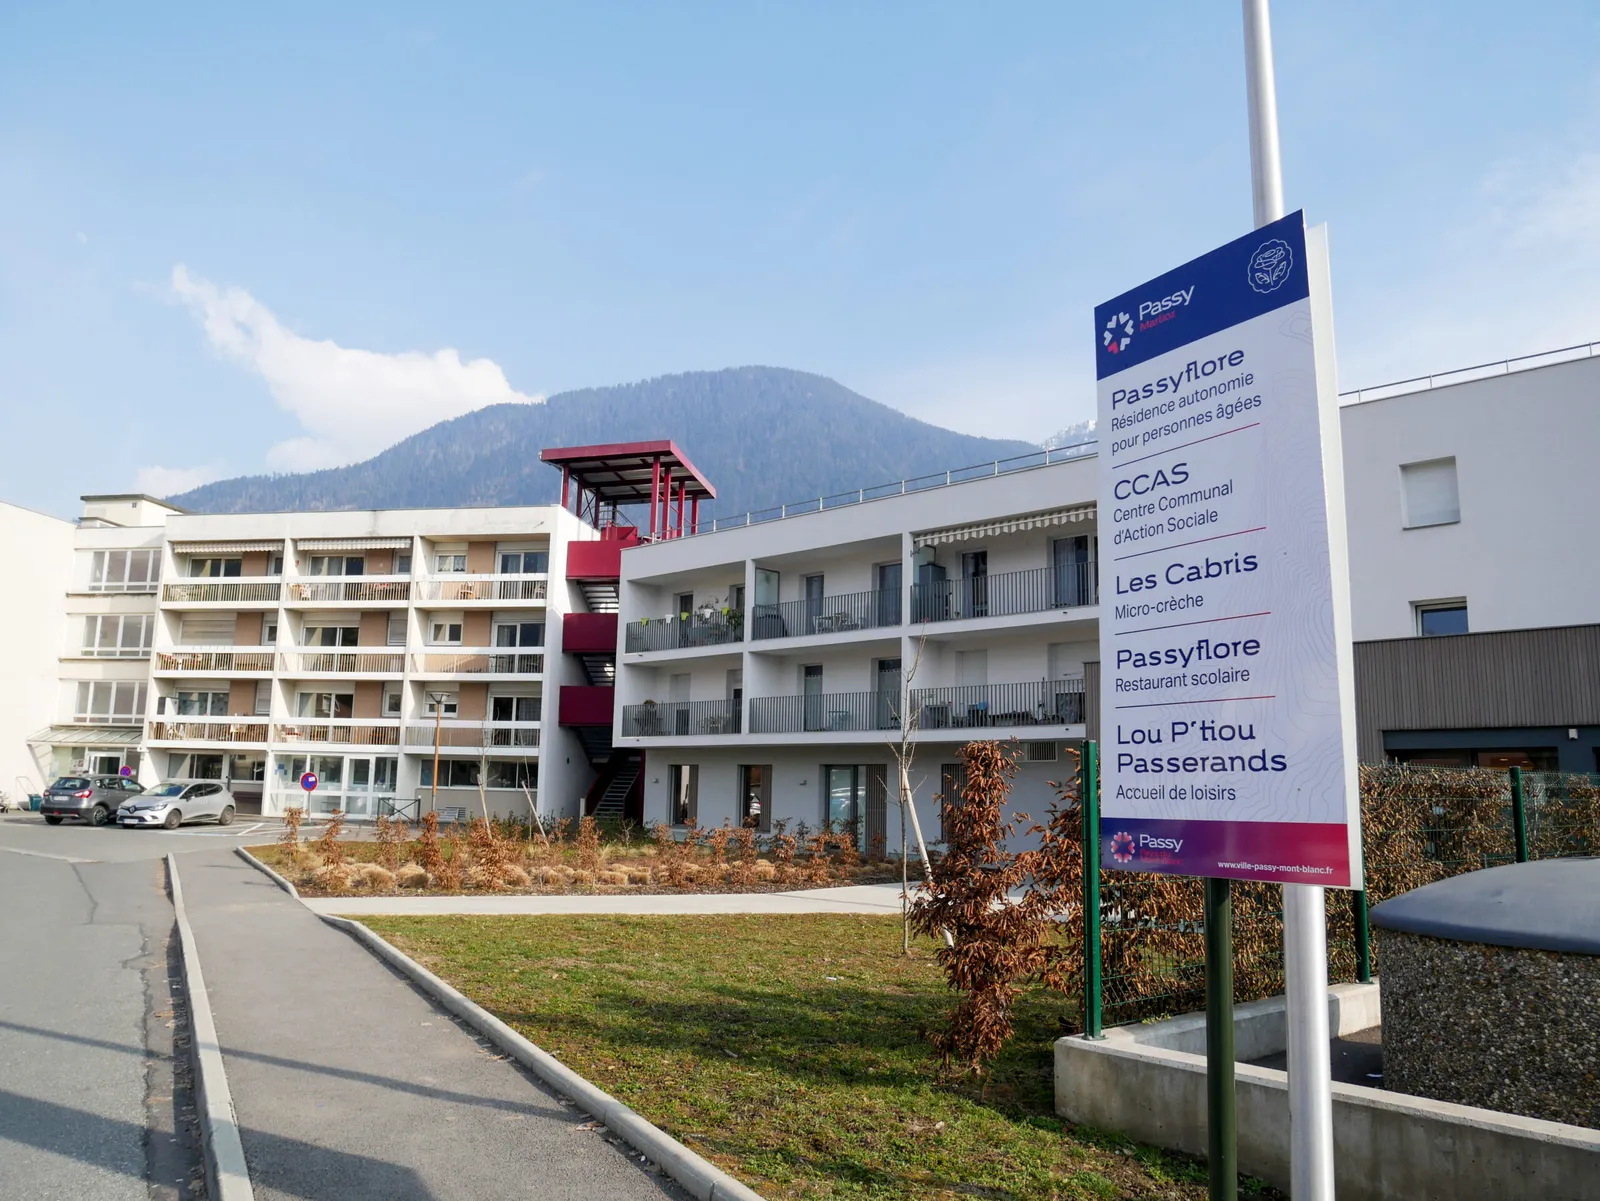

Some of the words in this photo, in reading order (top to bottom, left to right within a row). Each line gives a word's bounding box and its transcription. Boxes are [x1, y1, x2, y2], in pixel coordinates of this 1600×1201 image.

[1139, 285, 1195, 321] Passy
[1112, 350, 1244, 410] Passyflore
[1111, 403, 1175, 431] Résidence
[1178, 372, 1254, 408] autonomie
[1111, 434, 1140, 456] pour
[1142, 410, 1212, 446] personnes
[1215, 394, 1262, 420] âgées
[1114, 463, 1189, 500] CCAS
[1113, 503, 1156, 523] Centre
[1158, 479, 1233, 510] Communal
[1113, 522, 1164, 545] d'Action
[1167, 509, 1218, 532] Sociale
[1116, 573, 1157, 595] Les
[1165, 552, 1258, 584] Cabris
[1115, 594, 1204, 620] Micro-crèche
[1116, 638, 1261, 669] Passyflore
[1115, 673, 1188, 692] Restaurant
[1191, 667, 1250, 686] scolaire
[1117, 725, 1163, 745] Lou
[1171, 719, 1256, 742] P'tiou
[1117, 748, 1287, 773] Passerands
[1115, 785, 1165, 800] Accueil
[1168, 785, 1187, 800] de
[1191, 784, 1236, 800] loisirs
[1139, 834, 1184, 852] Passy
[1217, 861, 1333, 875] www.ville-passy-mont-blanc.fr
